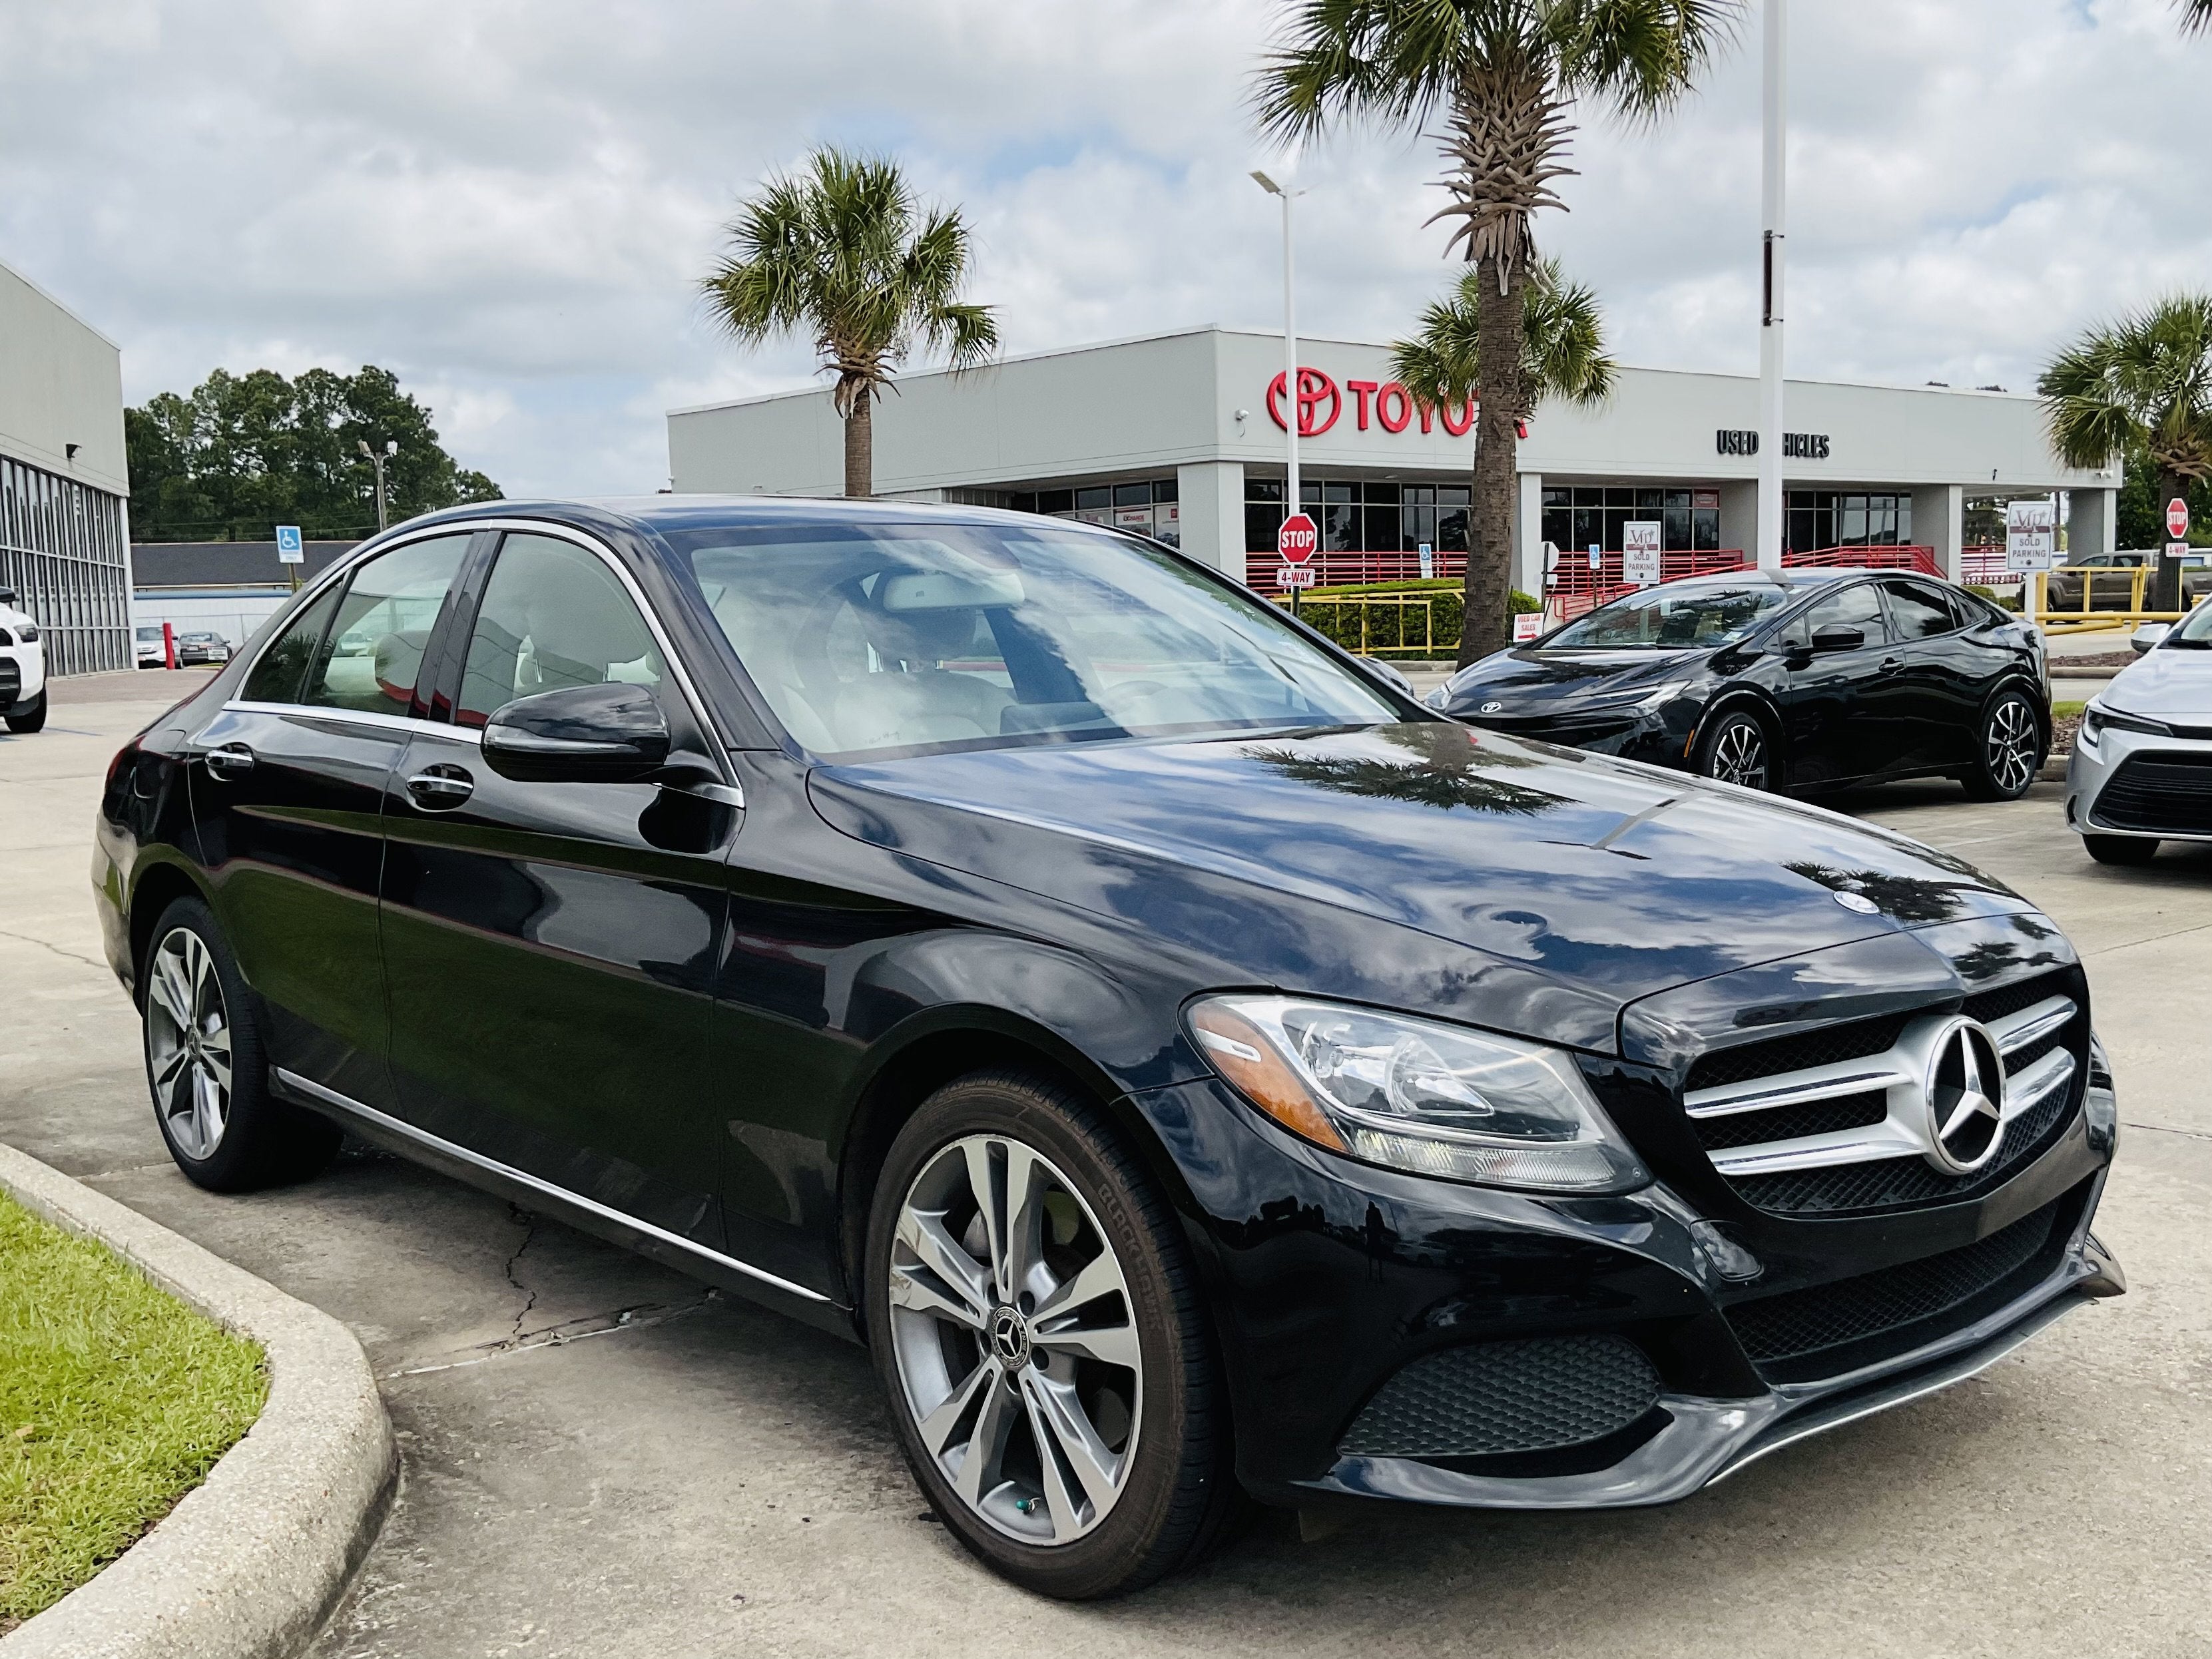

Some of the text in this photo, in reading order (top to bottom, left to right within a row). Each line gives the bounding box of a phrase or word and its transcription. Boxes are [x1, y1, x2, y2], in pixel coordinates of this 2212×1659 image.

[1717, 429, 1830, 458] USED HICLES
[2168, 511, 2186, 525] STOP
[1281, 530, 1314, 548] STOP
[2012, 549, 2046, 558] PARKING
[2168, 545, 2186, 555] 4-WAY
[1281, 572, 1310, 583] 4-WAY
